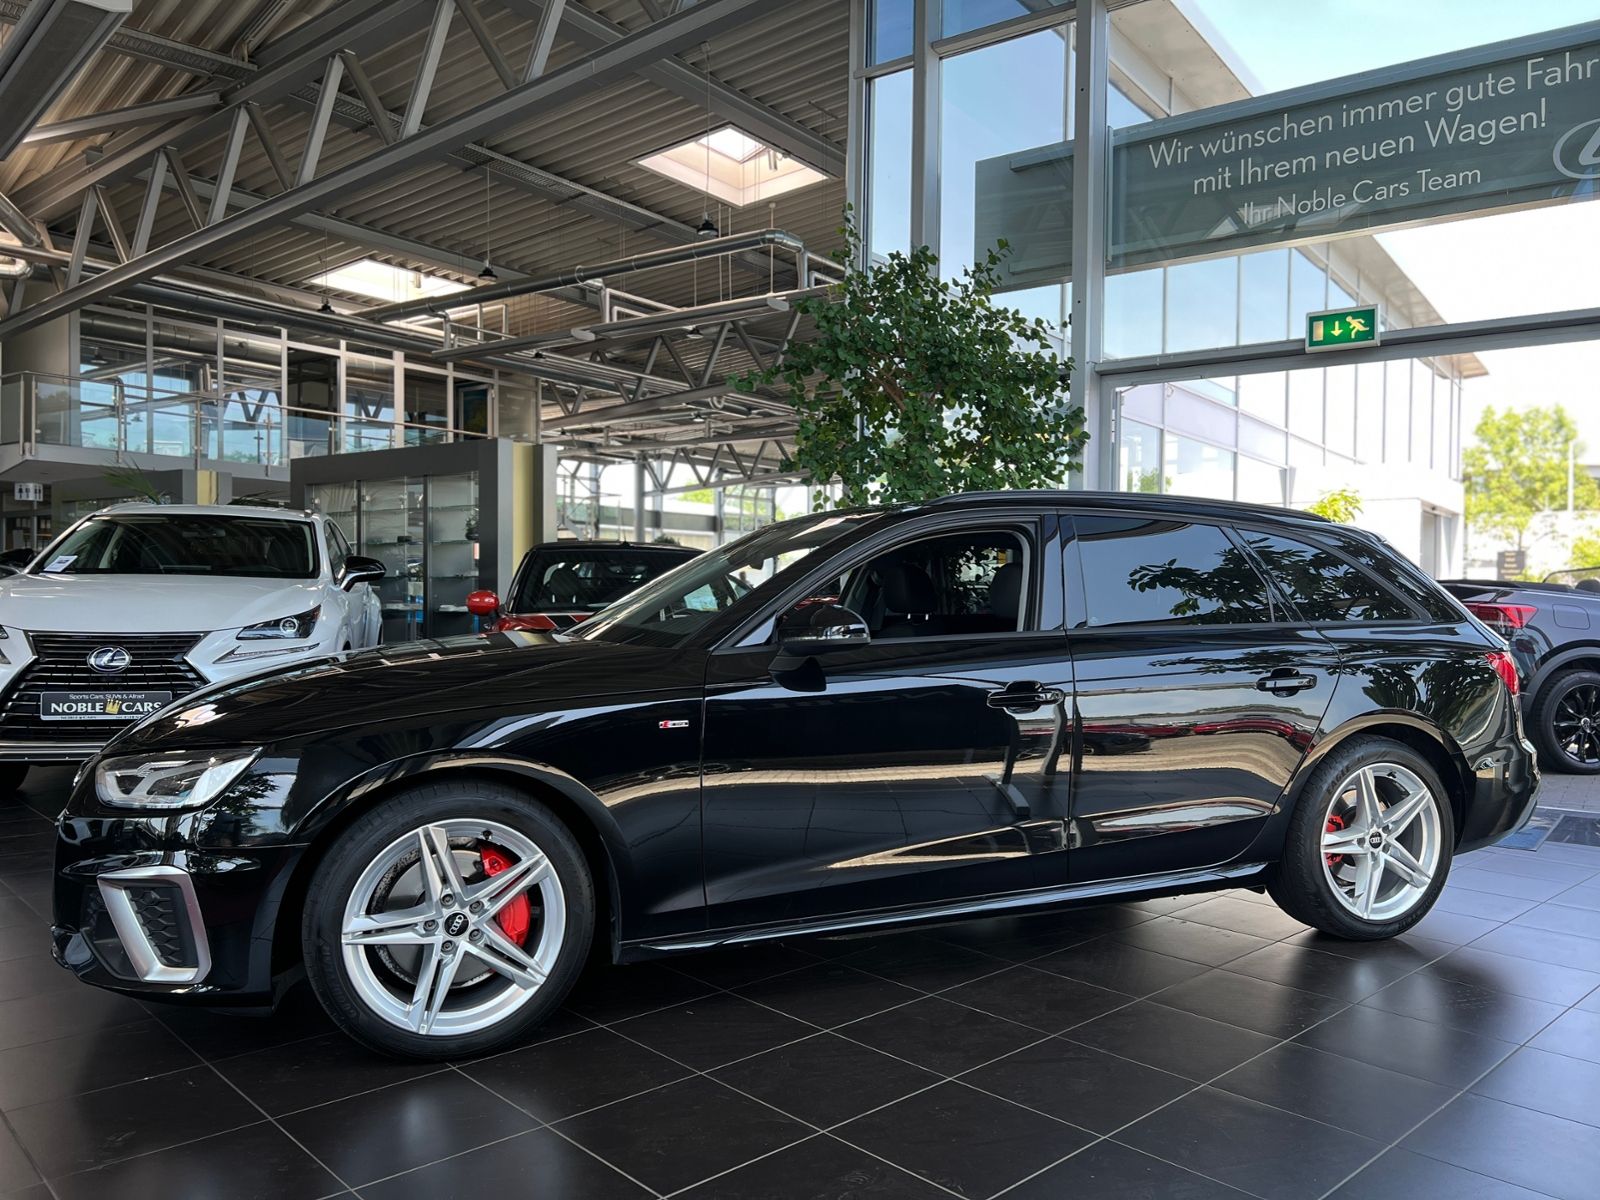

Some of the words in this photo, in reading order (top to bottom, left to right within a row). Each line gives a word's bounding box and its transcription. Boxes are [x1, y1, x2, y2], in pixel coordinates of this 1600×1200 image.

[1149, 138, 1193, 168] Wir
[1200, 113, 1333, 158] wünschen
[1342, 91, 1438, 128] immer
[1445, 73, 1516, 112] gute
[1527, 52, 1600, 90] Fahr
[1194, 165, 1231, 194] mit
[1240, 157, 1316, 185] Ihrem
[1325, 135, 1415, 168] neuen
[1424, 97, 1547, 147] Wagen!
[1243, 202, 1272, 225] Ihr
[1277, 187, 1345, 218] Noble
[1352, 179, 1410, 204] Cars
[1416, 168, 1481, 193] Team
[50, 702, 104, 713] NOBLE
